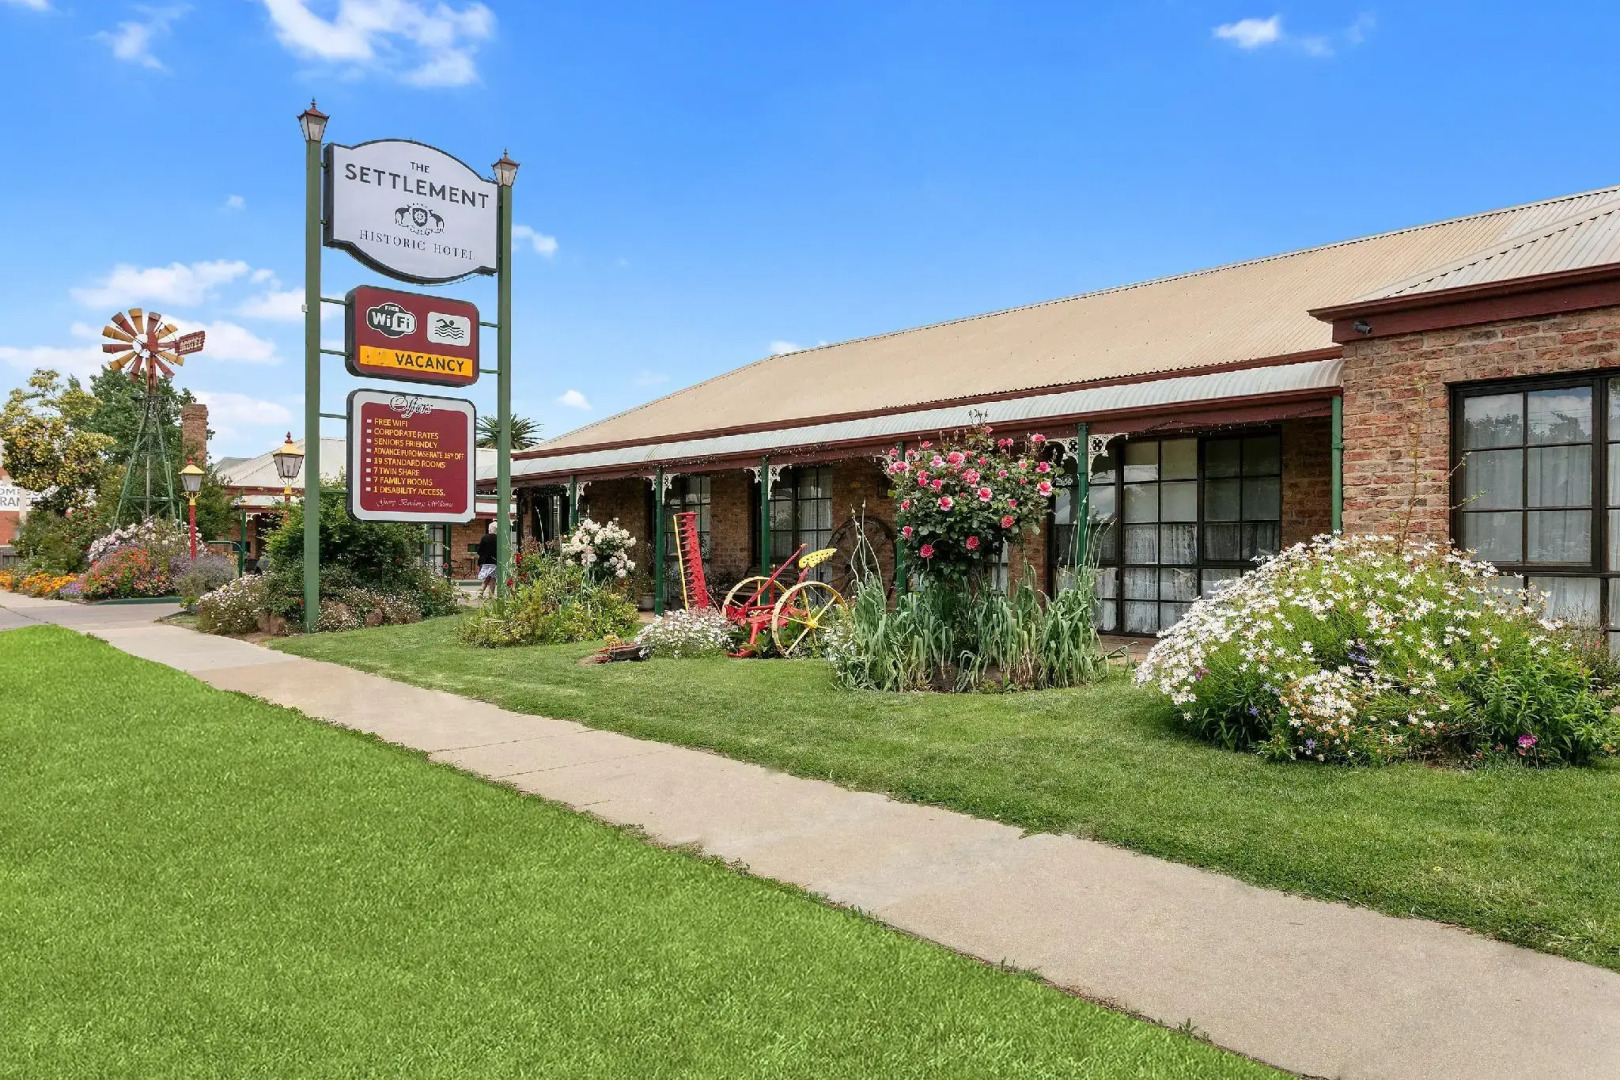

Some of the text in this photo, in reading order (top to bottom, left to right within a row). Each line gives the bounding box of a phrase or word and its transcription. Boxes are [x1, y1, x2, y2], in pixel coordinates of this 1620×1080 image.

[410, 161, 430, 174] THE
[344, 163, 489, 209] SETTLEMENT
[359, 229, 476, 261] HISTORIC HOTEL
[395, 352, 465, 373] VACANCY
[374, 418, 392, 426] FREE
[374, 428, 438, 439] CORPORATE RATES
[374, 438, 438, 449] SENIORS FRIENDLY
[374, 448, 400, 456] ADVANCE
[400, 449, 429, 458] PURCHASE
[384, 458, 420, 467] STANDARD
[422, 460, 446, 468] ROOMS
[379, 467, 397, 476] TWIN
[380, 477, 406, 486] FAMILY
[407, 478, 433, 486] ROOMS
[380, 486, 416, 495] DISABILITY
